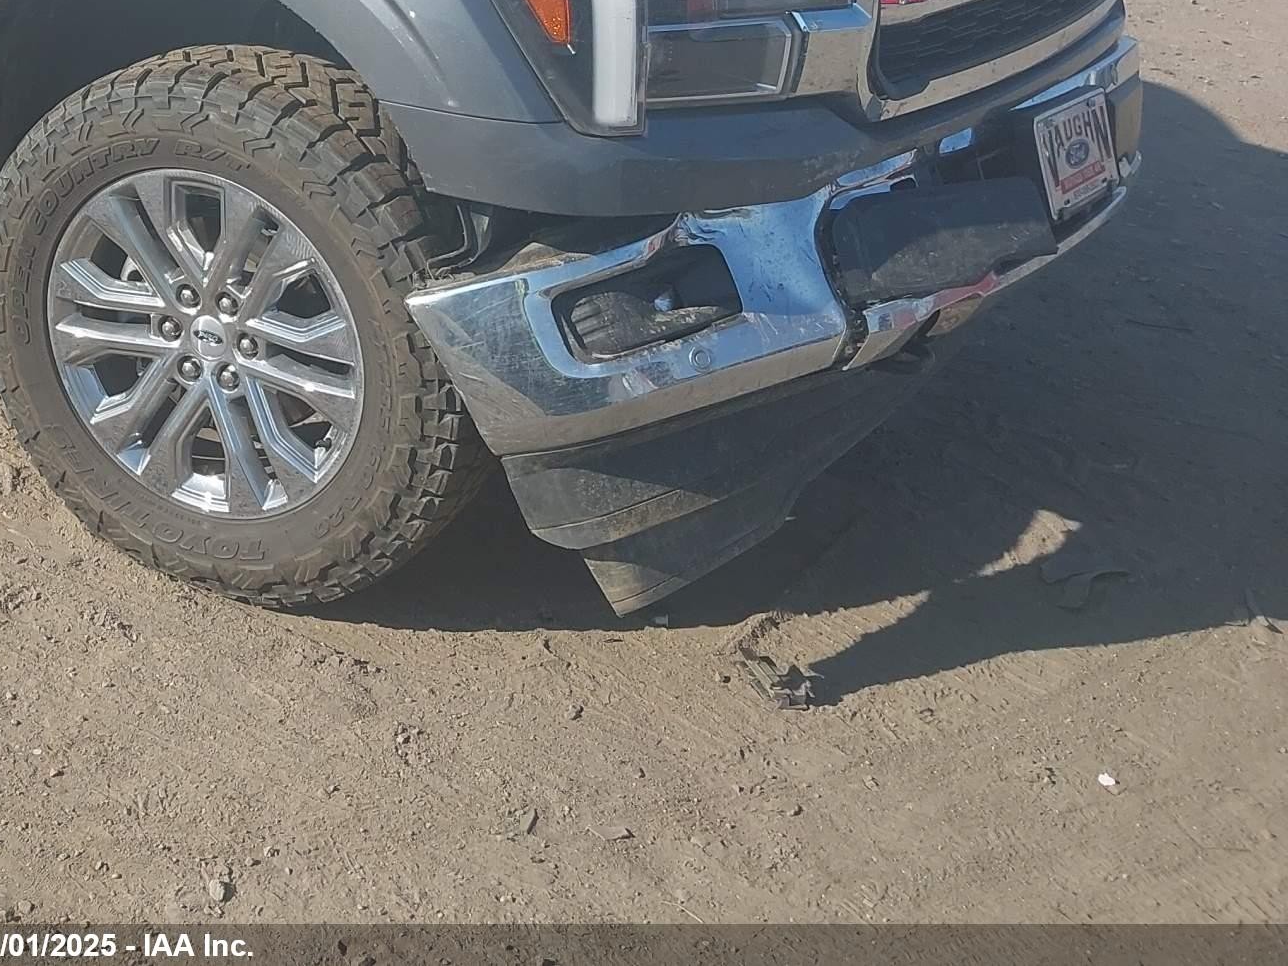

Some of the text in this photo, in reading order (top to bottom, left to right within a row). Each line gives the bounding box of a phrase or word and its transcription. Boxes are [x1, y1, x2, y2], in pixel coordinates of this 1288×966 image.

[28, 137, 161, 236] COUNTRY
[174, 138, 253, 172] R/T
[1041, 105, 1113, 188] VAUGHN
[152, 522, 265, 561] TOYO
